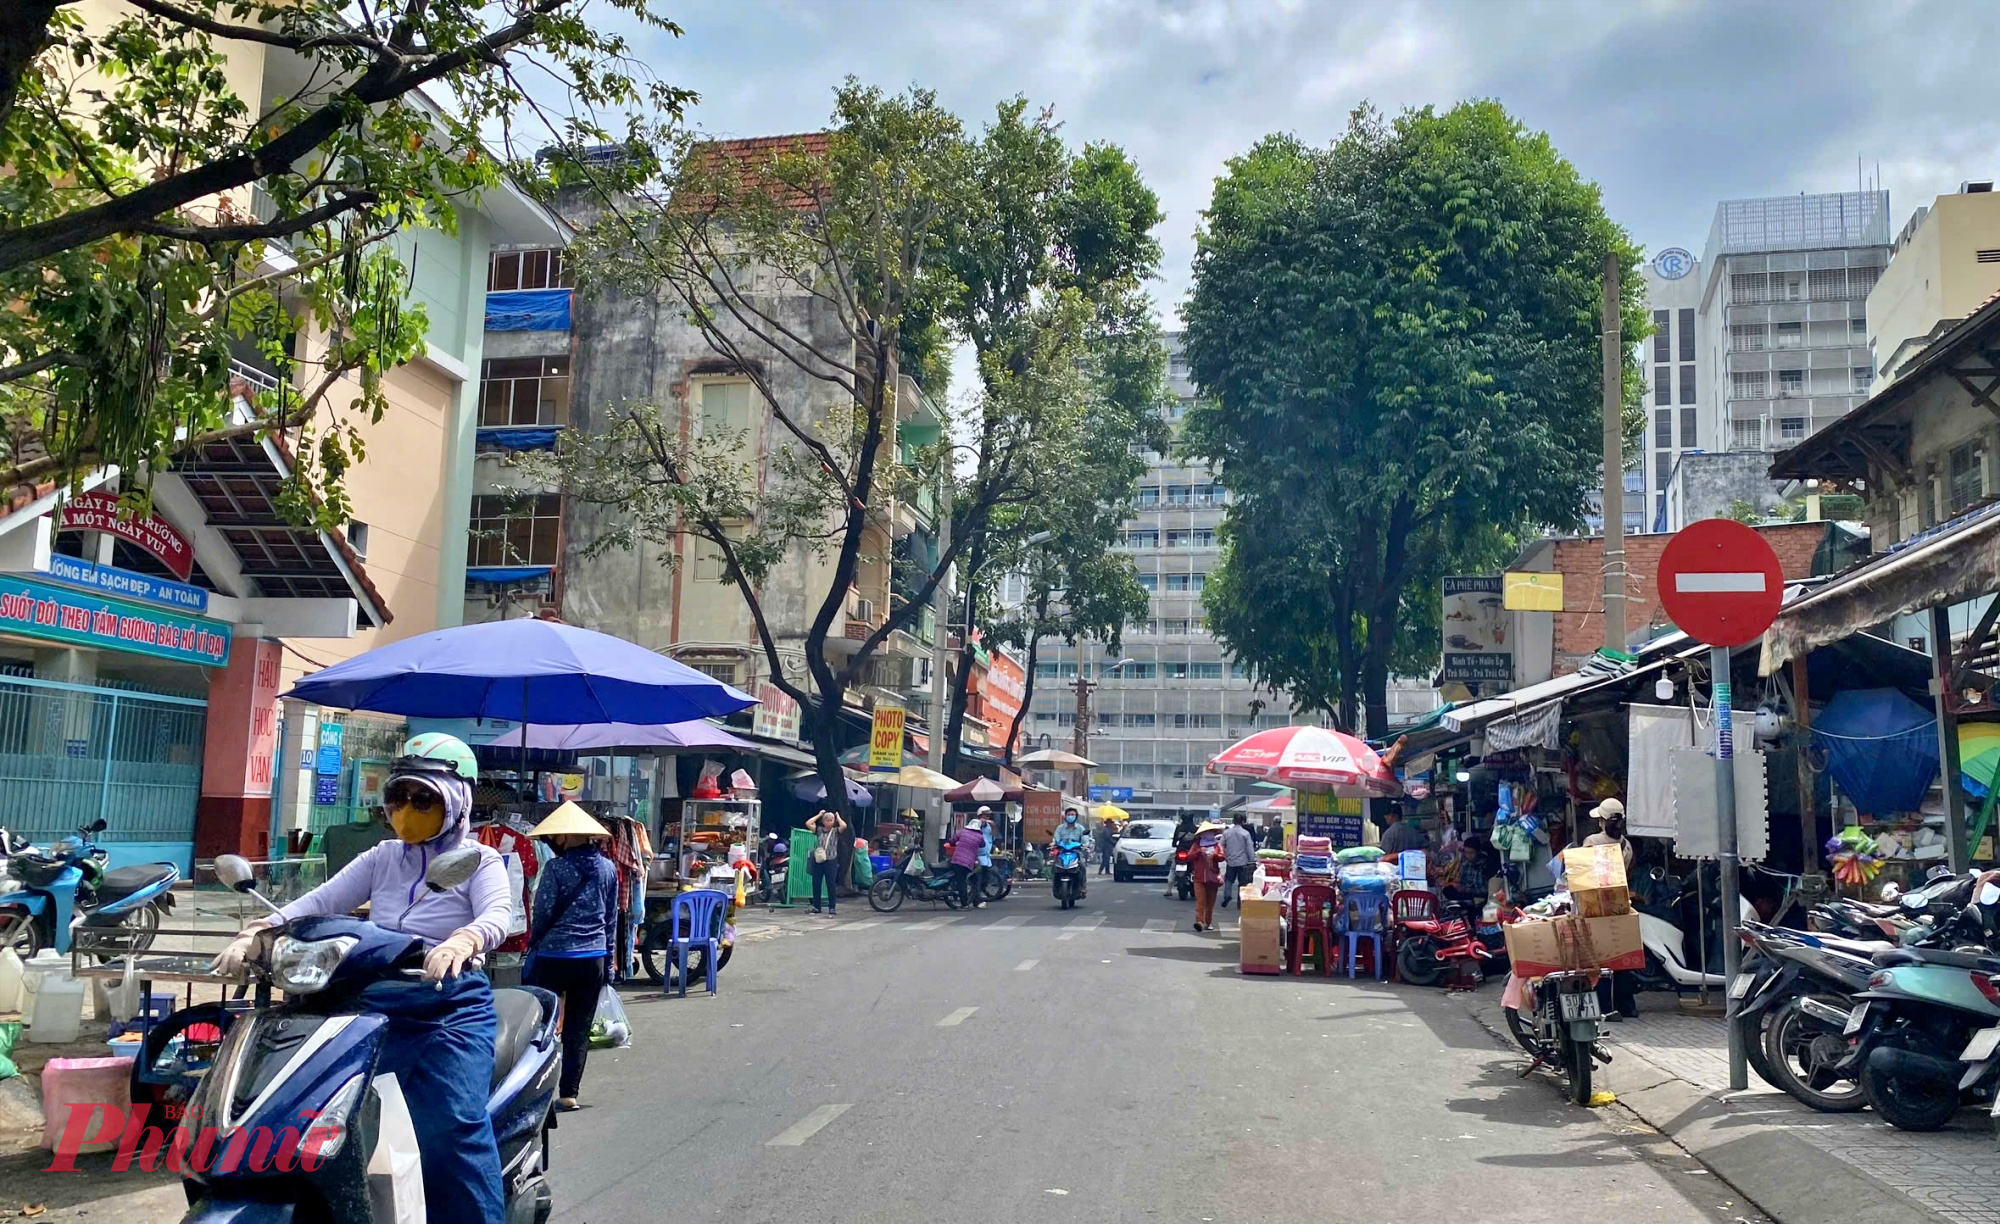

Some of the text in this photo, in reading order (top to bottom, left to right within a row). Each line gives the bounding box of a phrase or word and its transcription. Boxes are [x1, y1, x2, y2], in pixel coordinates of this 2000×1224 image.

[73, 511, 104, 528] MỘT
[107, 517, 143, 540] NGÀY
[145, 533, 167, 556] VUI
[81, 568, 98, 584] EM
[100, 573, 128, 591] SẠCH
[130, 577, 150, 597] ĐẸP
[159, 587, 173, 601] AN
[174, 589, 201, 606] TOÀN
[1444, 578, 1456, 591] CÀ
[1457, 578, 1472, 591] PHÊ
[1473, 580, 1490, 591] PHA
[0, 588, 35, 619] SUỐT
[35, 594, 58, 627] ĐỜI
[60, 604, 90, 632] THEO
[92, 604, 118, 637] TẤM
[119, 617, 157, 644] GƯƠNG
[158, 622, 180, 648] BÁC
[207, 634, 225, 660] ĐẠI
[257, 651, 278, 693] HẬU
[253, 708, 274, 741] HỌC
[875, 709, 903, 729] PHOTO
[875, 730, 899, 750] COPY
[302, 750, 312, 763] 10
[1322, 755, 1347, 763] VIP
